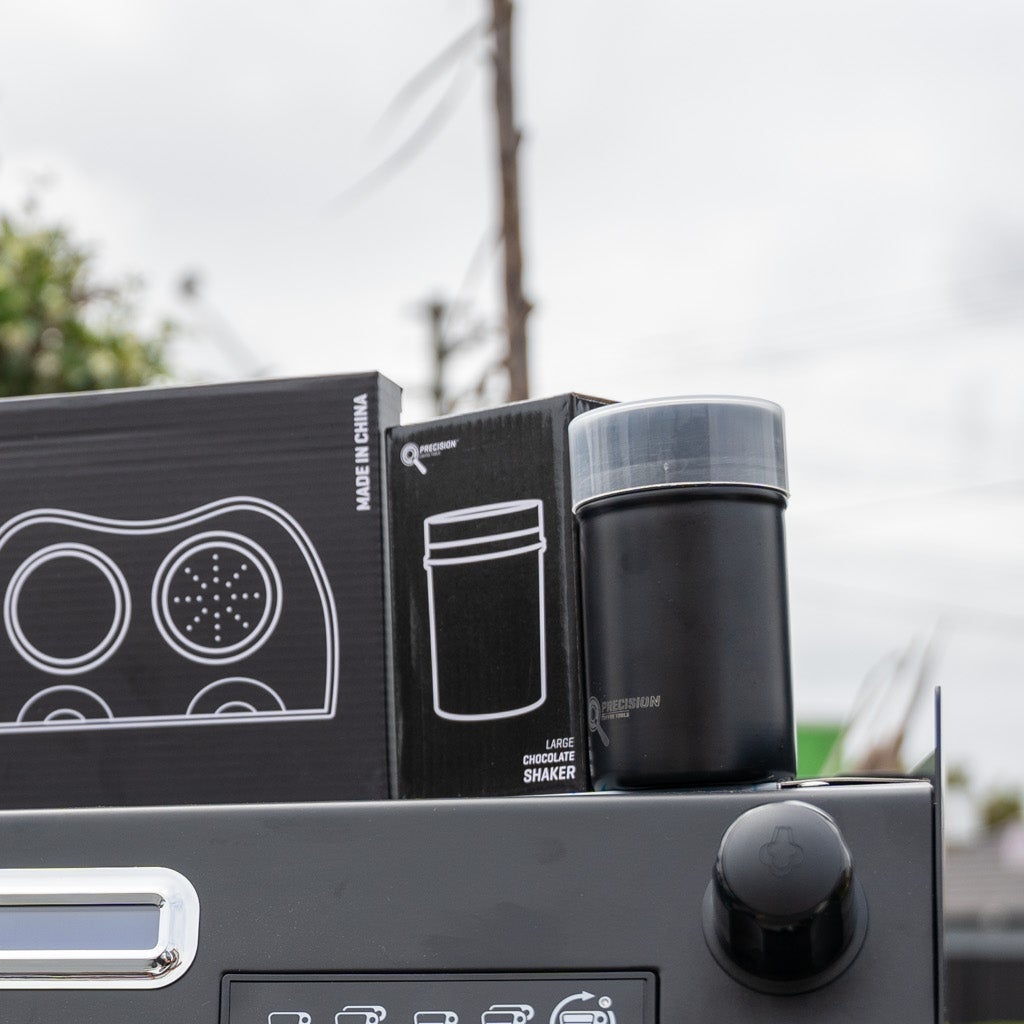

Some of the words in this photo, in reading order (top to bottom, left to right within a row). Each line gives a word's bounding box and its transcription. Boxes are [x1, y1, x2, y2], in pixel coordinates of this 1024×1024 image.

[353, 393, 369, 444] CHINA
[355, 446, 370, 463] IN
[419, 439, 457, 454] PRECISION
[355, 465, 371, 511] MADE
[601, 695, 661, 713] PRECISION
[545, 737, 575, 750] LARGE
[522, 750, 575, 766] CHOCOLATE
[523, 765, 576, 784] SHAKER
